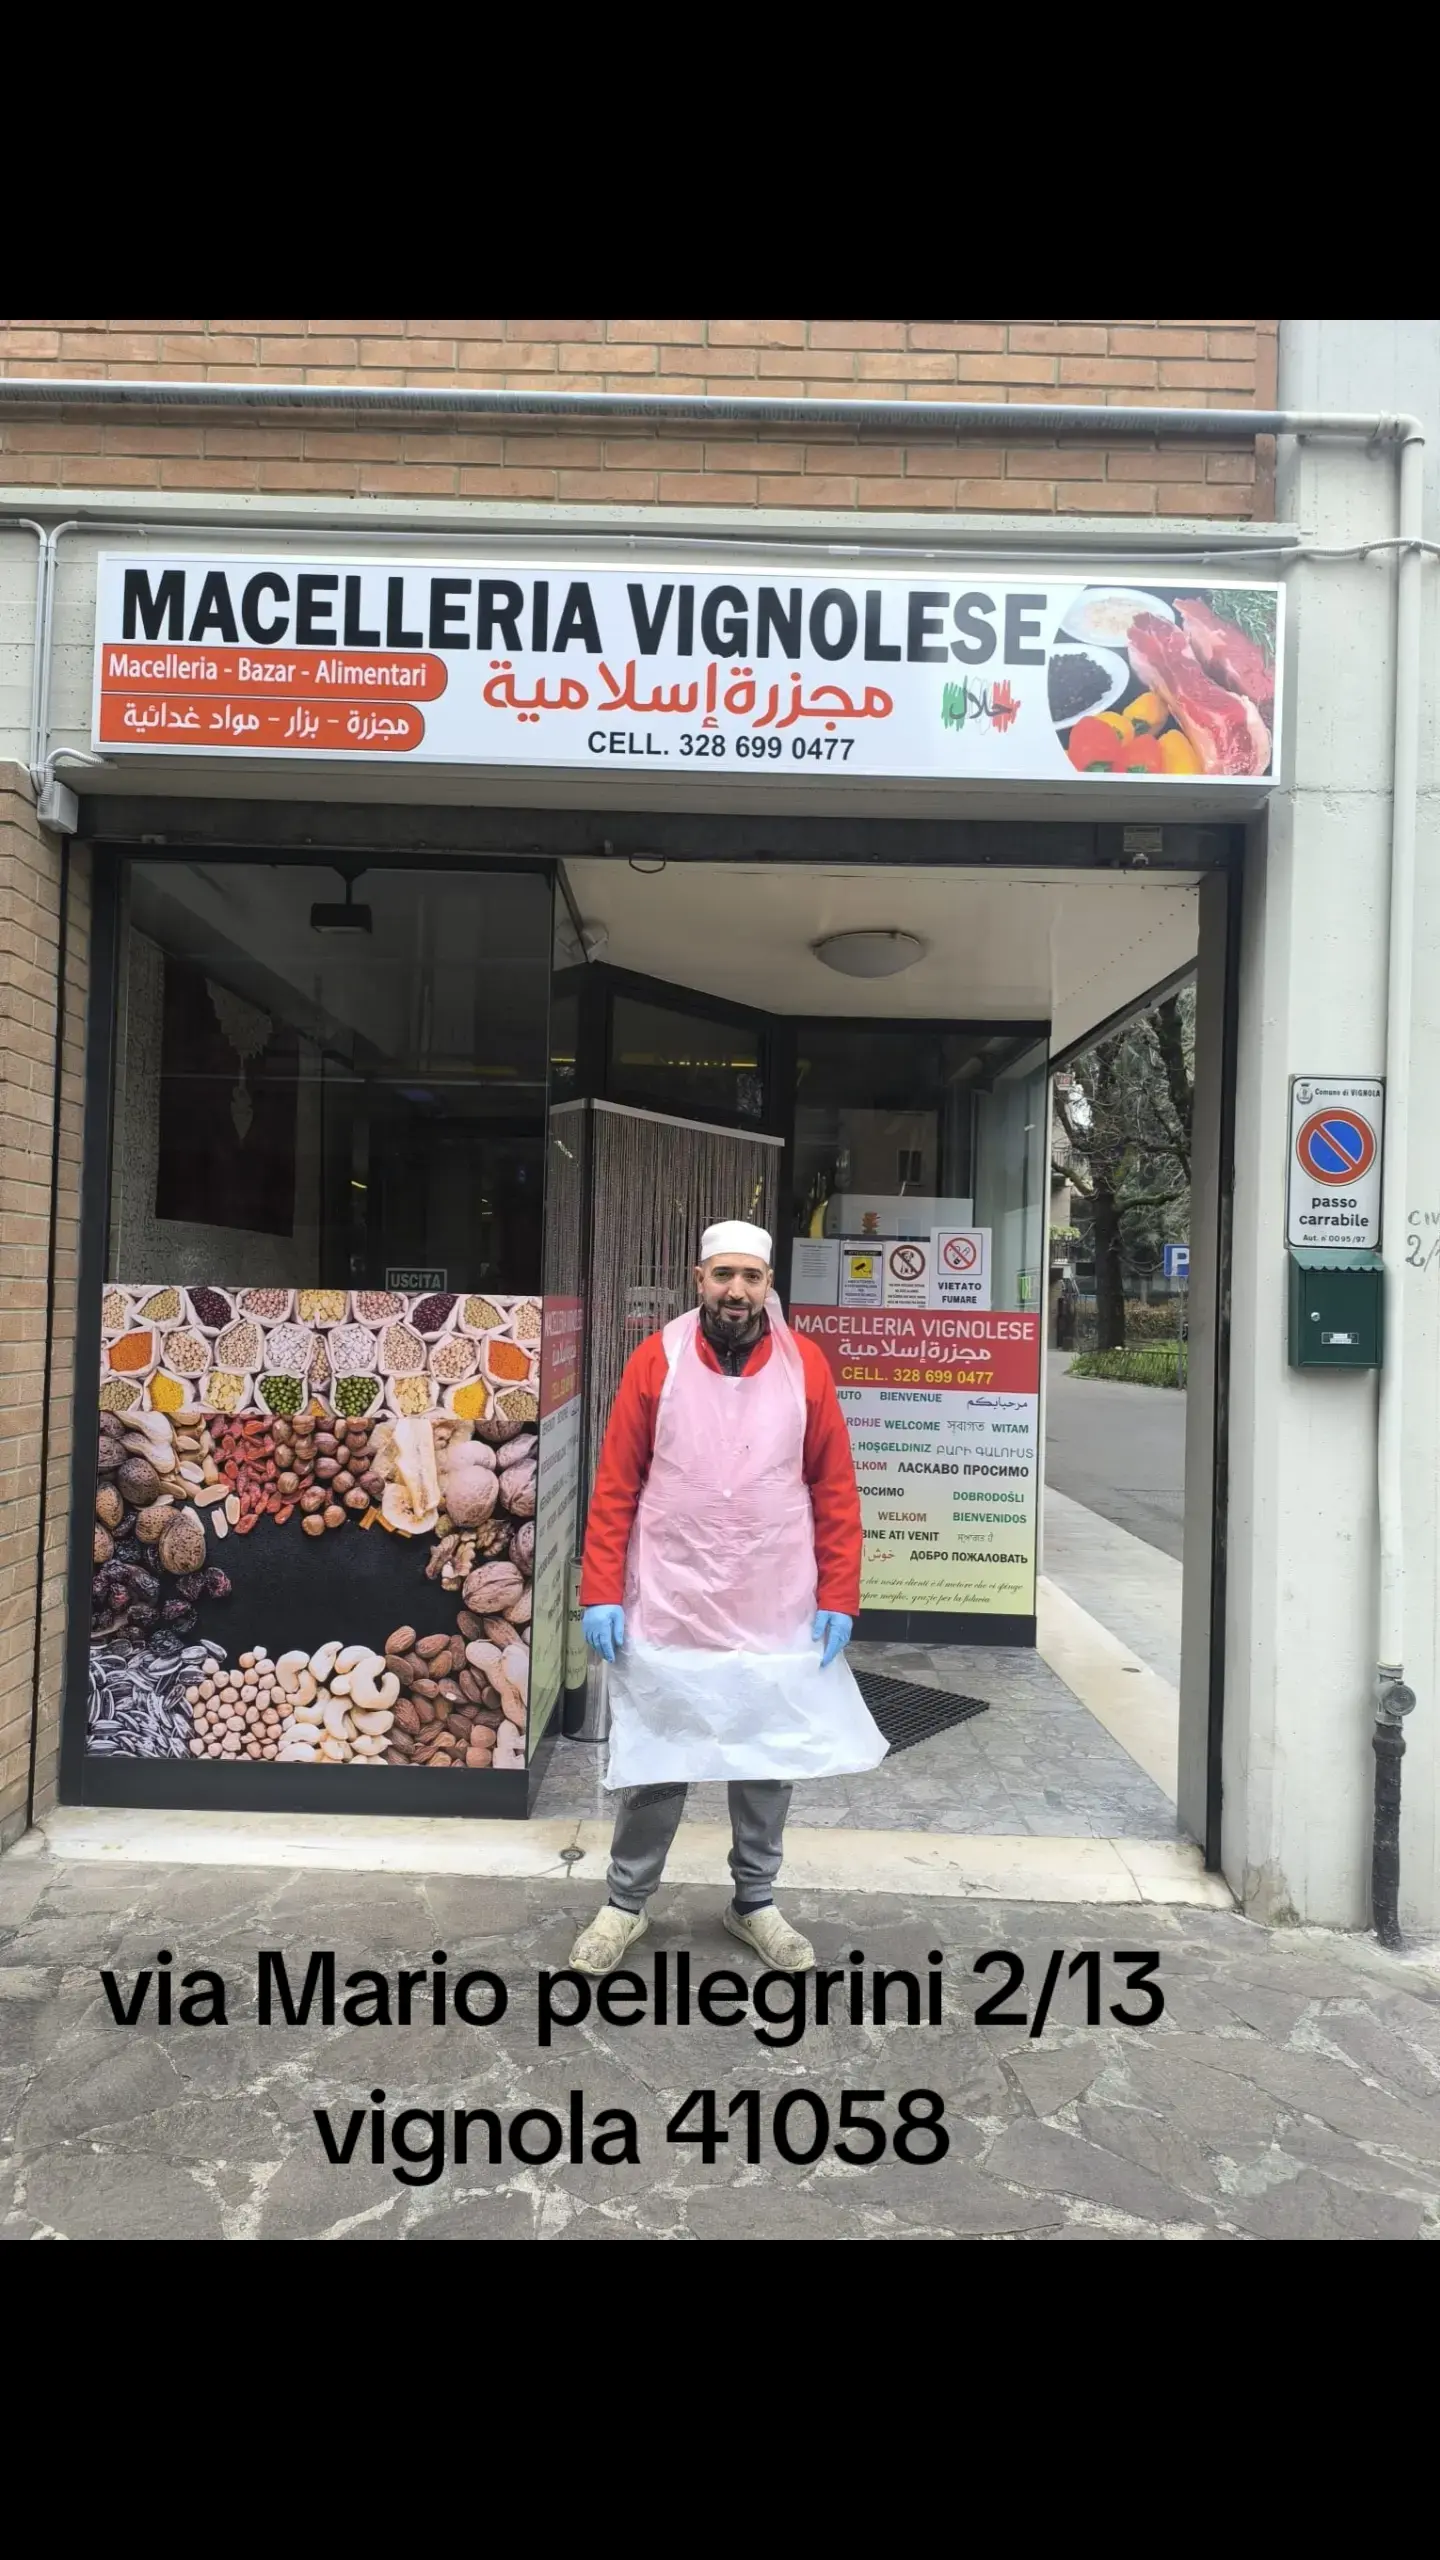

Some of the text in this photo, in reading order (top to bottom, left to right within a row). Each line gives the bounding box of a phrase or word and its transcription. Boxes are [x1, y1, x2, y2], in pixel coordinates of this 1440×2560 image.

[122, 569, 1047, 666] MACELLERIA VIGNOLESE
[108, 653, 217, 681] Macelleria
[238, 658, 297, 683] Bazar
[315, 659, 427, 687] Alimentari
[483, 660, 894, 731] مجزرة إسلامية
[209, 704, 260, 735] مواد
[285, 706, 319, 739] بزار
[347, 709, 410, 741] مجزرة
[587, 731, 855, 760] CELL. 328 699 0477
[1351, 1089, 1380, 1097] VIGNOLA
[1312, 1197, 1357, 1209] passo
[1299, 1214, 1369, 1227] carrabile
[1303, 1234, 1317, 1242] Aut.
[1171, 1247, 1190, 1276] P
[391, 1273, 441, 1289] USCITA
[938, 1282, 982, 1291] VIETATO
[942, 1296, 977, 1304] FUMARE
[794, 1315, 1035, 1341] MACELLERIA VIGNOLESE
[838, 1338, 992, 1364] مجزرة إسلامية
[842, 1367, 994, 1385] CELL. 328 699 0477
[880, 1391, 942, 1403] BIENVENUE
[846, 1417, 940, 1431] RDHJE WELCOME
[991, 1423, 1029, 1434] WITAM
[897, 1462, 1029, 1478] ЛАСКАВО ПРОСИМО
[856, 1486, 904, 1497] РОСИМО
[953, 1491, 1024, 1503] DOBRODOŠLI
[878, 1511, 927, 1522] WELKOM
[952, 1512, 1027, 1524] BIENVENIDOS
[888, 1530, 905, 1540] ATI
[907, 1531, 940, 1541] VENIT
[910, 1550, 1028, 1564] ДОБРО ПОЖАЛОВАТЬ
